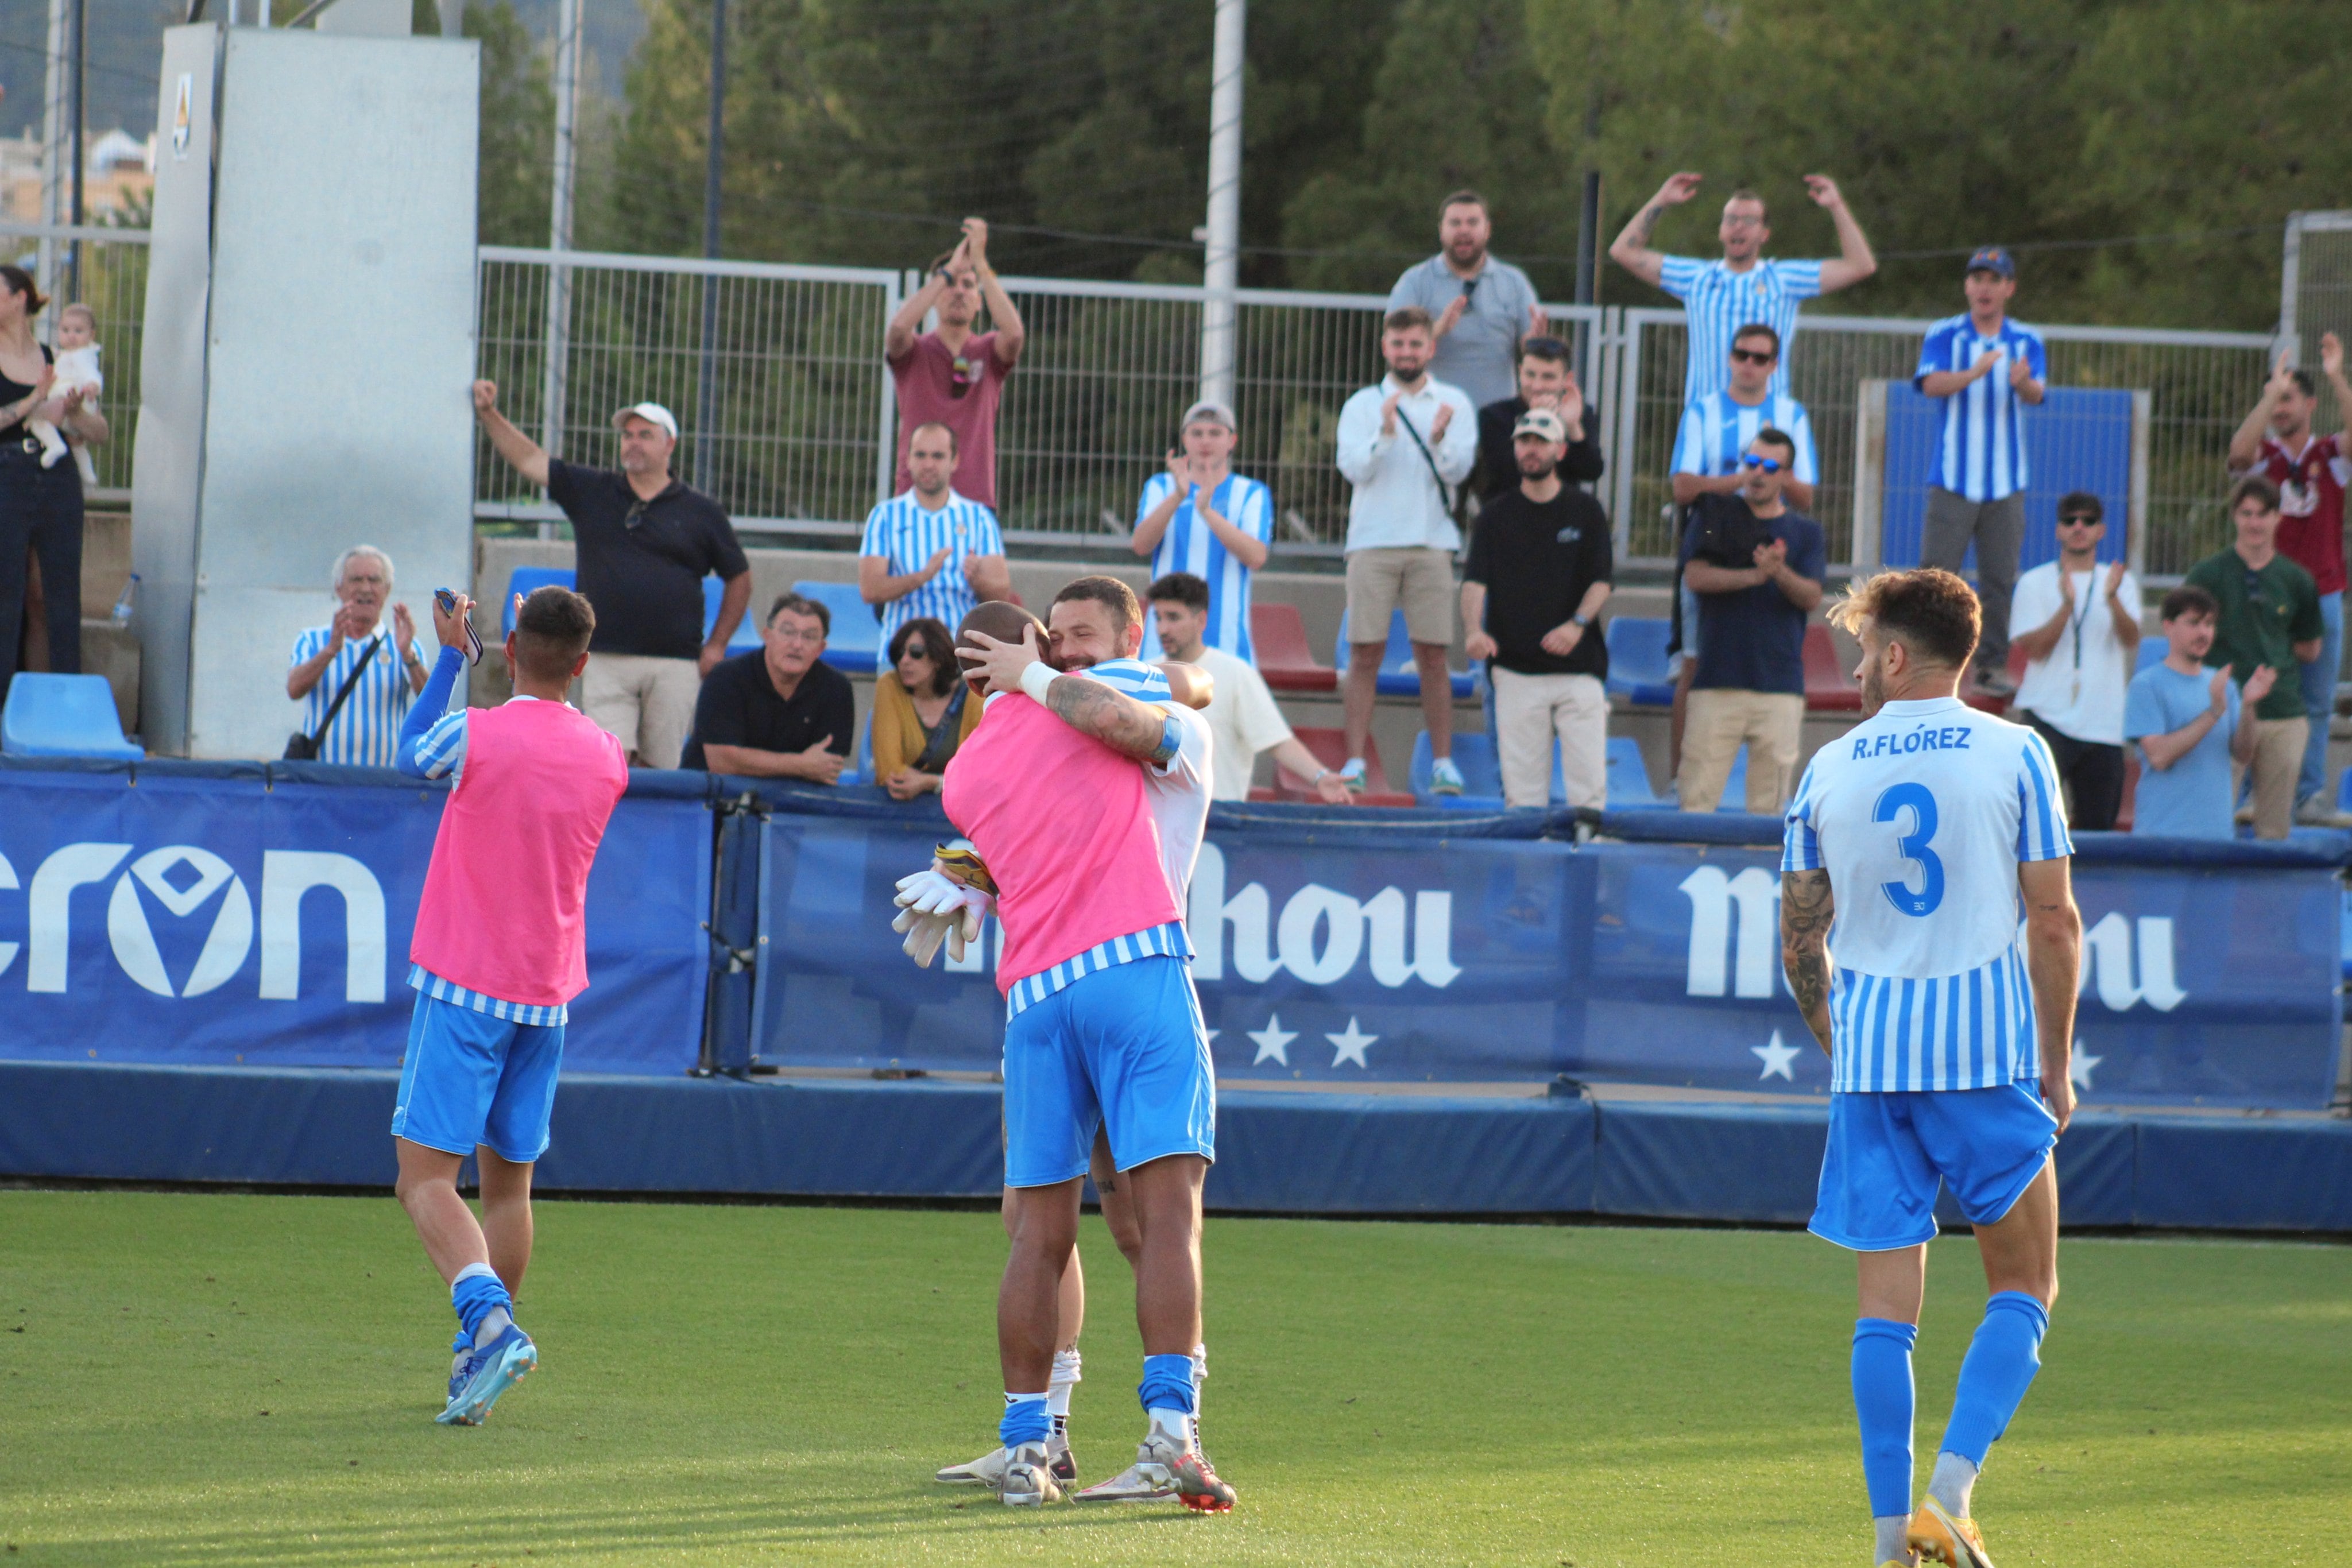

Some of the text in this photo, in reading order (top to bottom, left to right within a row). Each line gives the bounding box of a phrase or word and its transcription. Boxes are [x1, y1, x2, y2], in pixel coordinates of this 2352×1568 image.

[1852, 723, 1971, 760] R.FLÓREZ
[1871, 782, 1945, 917] 3
[0, 842, 387, 1003] ron
